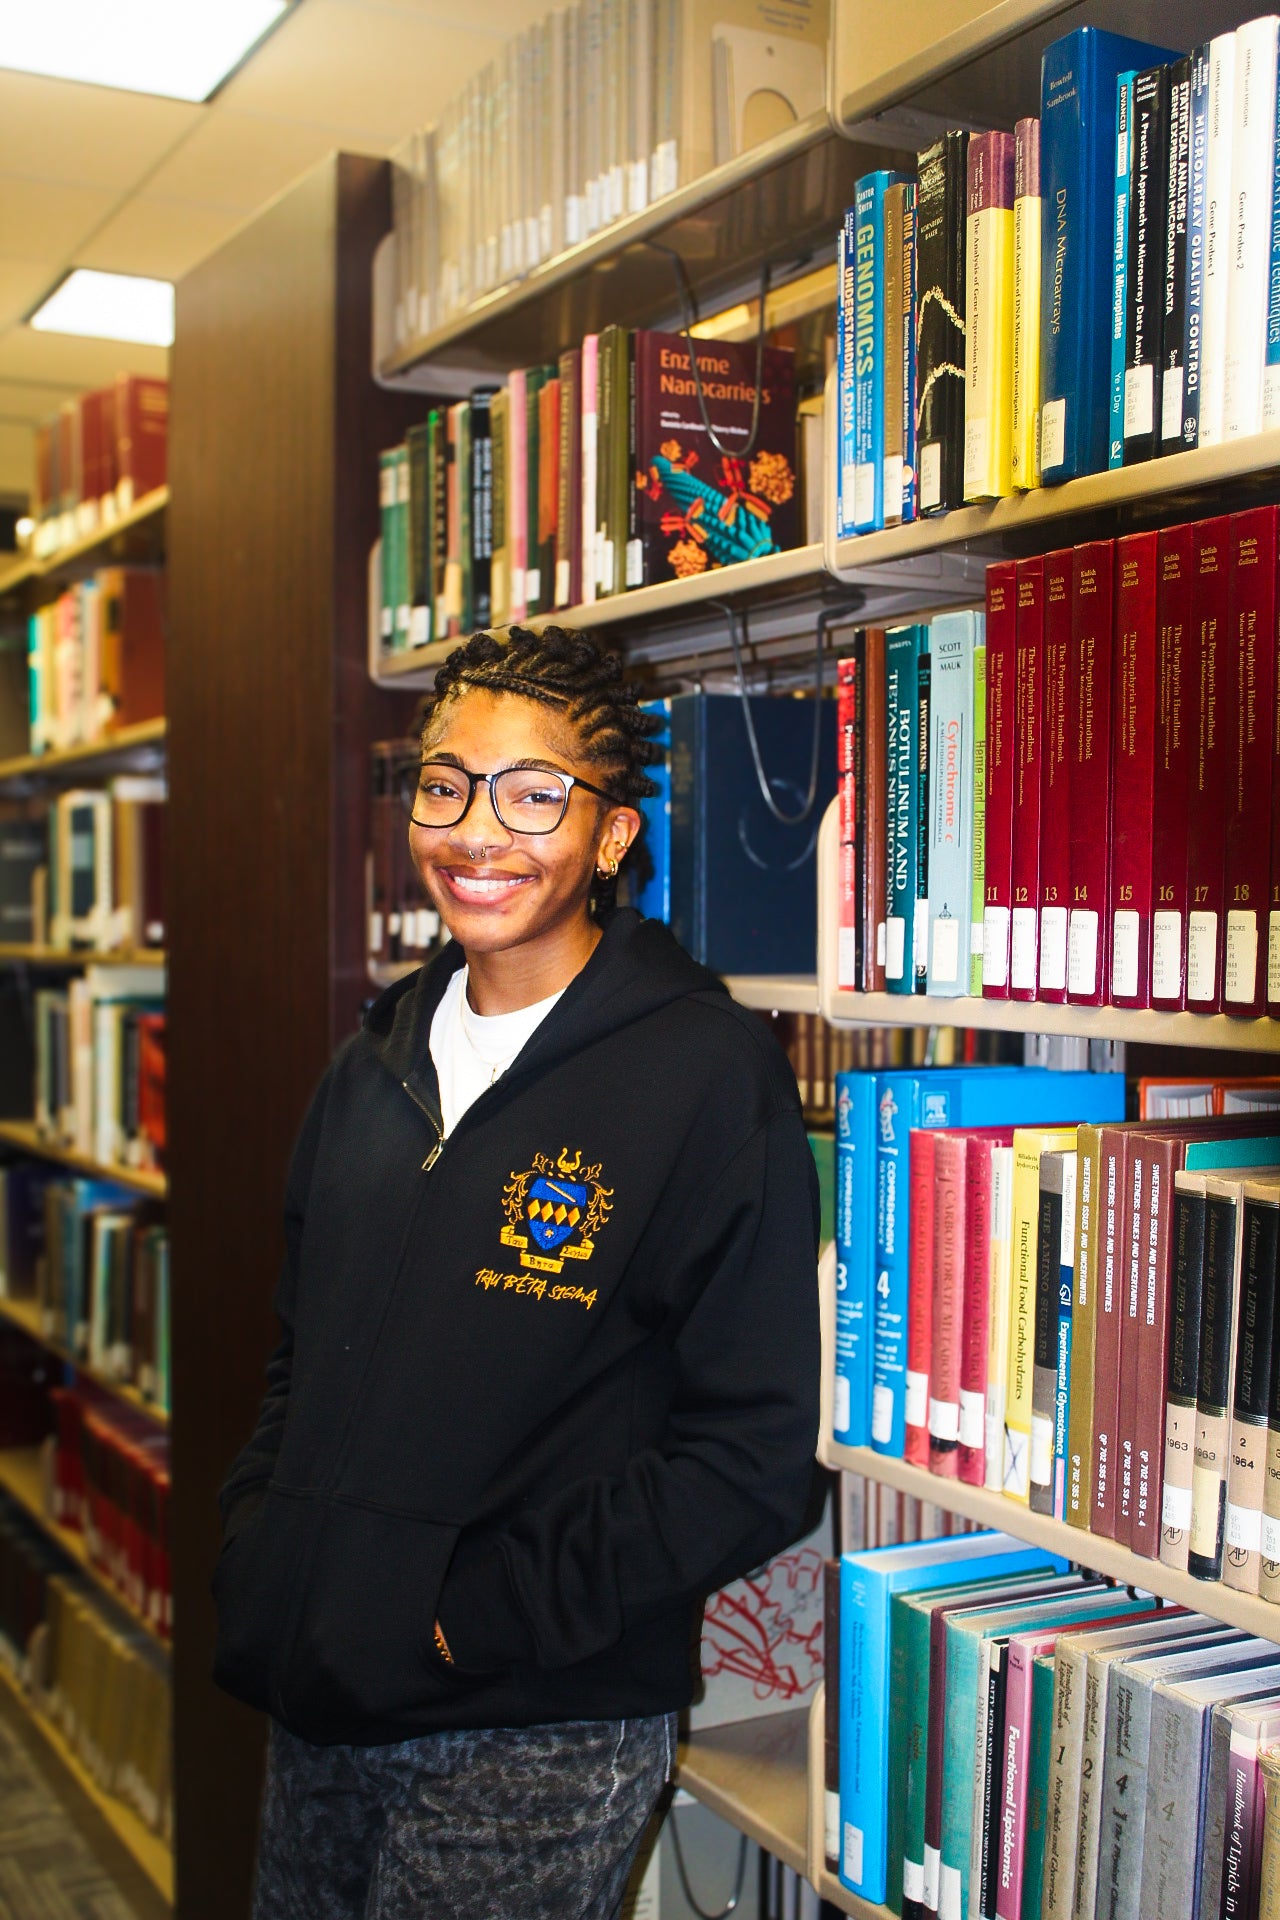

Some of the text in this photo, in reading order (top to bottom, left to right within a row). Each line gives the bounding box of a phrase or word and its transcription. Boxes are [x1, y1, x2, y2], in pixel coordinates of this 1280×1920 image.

[1047, 88, 1076, 109] Sambrook
[1141, 112, 1150, 122] A
[1118, 134, 1126, 175] METHODS
[1140, 124, 1149, 172] Practical
[1176, 82, 1190, 234] STATISTICAL ANALYSIS of
[857, 187, 874, 202] CANTOR
[1138, 174, 1148, 228] Approach
[1166, 86, 1179, 316] GENE EXPRESSION MICROARRAY DATA
[858, 201, 873, 216] SMITH
[920, 216, 944, 234] KORNBERG
[1115, 193, 1126, 260] Microarrays
[1138, 229, 1146, 241] to
[1236, 192, 1246, 270] Gene Probes 2
[902, 212, 913, 314] DNA Sequencing
[1052, 188, 1066, 335] DNA Microarrays
[1115, 263, 1124, 274] &
[1188, 115, 1204, 396] MICROARRAY QUALITY CONTROL
[973, 270, 979, 282] of
[1136, 243, 1146, 303] Microarray
[856, 223, 874, 377] GENOMICS
[1114, 275, 1124, 340] Microplates
[1135, 306, 1144, 332] Data
[660, 348, 730, 375] Enzme
[844, 266, 854, 436] UNDERSTANDING DNA
[660, 374, 771, 404] Nancarries
[1112, 394, 1121, 414] Day
[939, 642, 961, 653] SCOTT
[940, 661, 962, 672] MAUK
[1058, 664, 1066, 712] Porphyrin
[1086, 660, 1094, 708] Porphyrin
[1026, 646, 1036, 763] The Porphyrin Handbook
[888, 668, 898, 772] TETANUS
[976, 740, 985, 774] Heme
[944, 720, 958, 842] Cytochrome c
[975, 780, 985, 803] and
[844, 724, 853, 900] Protein Sequencing Protocols
[896, 709, 910, 890] BOTULINUM AND
[986, 886, 998, 900] 11
[1016, 887, 1028, 901] 12
[1045, 886, 1058, 900] 13
[1074, 886, 1088, 900] 14
[1120, 885, 1132, 900] 15
[1160, 885, 1174, 900] 16
[1194, 886, 1209, 902] 17
[1234, 884, 1250, 900] 18
[1081, 1204, 1089, 1230] ISSUES
[1106, 1209, 1114, 1236] ISSUES
[1080, 1232, 1088, 1248] AND
[475, 1267, 598, 1310] TAU BETA SIGMA
[836, 1263, 848, 1291] 3
[877, 1270, 890, 1299] 4
[1038, 1202, 1052, 1360] THE AMINO SUGARS
[1078, 1250, 1088, 1306] UNCERTAINTIES
[1104, 1255, 1113, 1312] UNCERTAINTIES
[1016, 1220, 1030, 1400] Functional Food Carbohydrates
[1055, 1322, 1069, 1454] Experimental Glycoscience
[1173, 1422, 1178, 1430] 1
[1201, 1431, 1206, 1439] 1
[1140, 1450, 1148, 1462] QP
[1167, 1438, 1188, 1451] 1963
[1195, 1446, 1216, 1461] 1963
[1240, 1438, 1246, 1448] 2
[1140, 1464, 1148, 1480] 702
[1232, 1454, 1254, 1470] 1964
[1072, 1454, 1080, 1510] QP 702 S85 S9
[1140, 1480, 1148, 1497] S85
[1138, 1510, 1144, 1518] c.
[1139, 1498, 1147, 1510] S9
[1116, 1686, 1126, 1757] Lipid Research
[975, 1696, 984, 1784] DIETARY FATS
[1056, 1746, 1066, 1765] 1
[1083, 1758, 1093, 1780] 2
[1054, 1777, 1062, 1804] Fatty
[1116, 1774, 1128, 1795] 4
[1002, 1726, 1020, 1890] Functional Lipidomics
[1162, 1802, 1175, 1822] 4
[1226, 1768, 1247, 1912] Handbook of Lipids in
[1048, 1857, 1058, 1910] Glycerides
